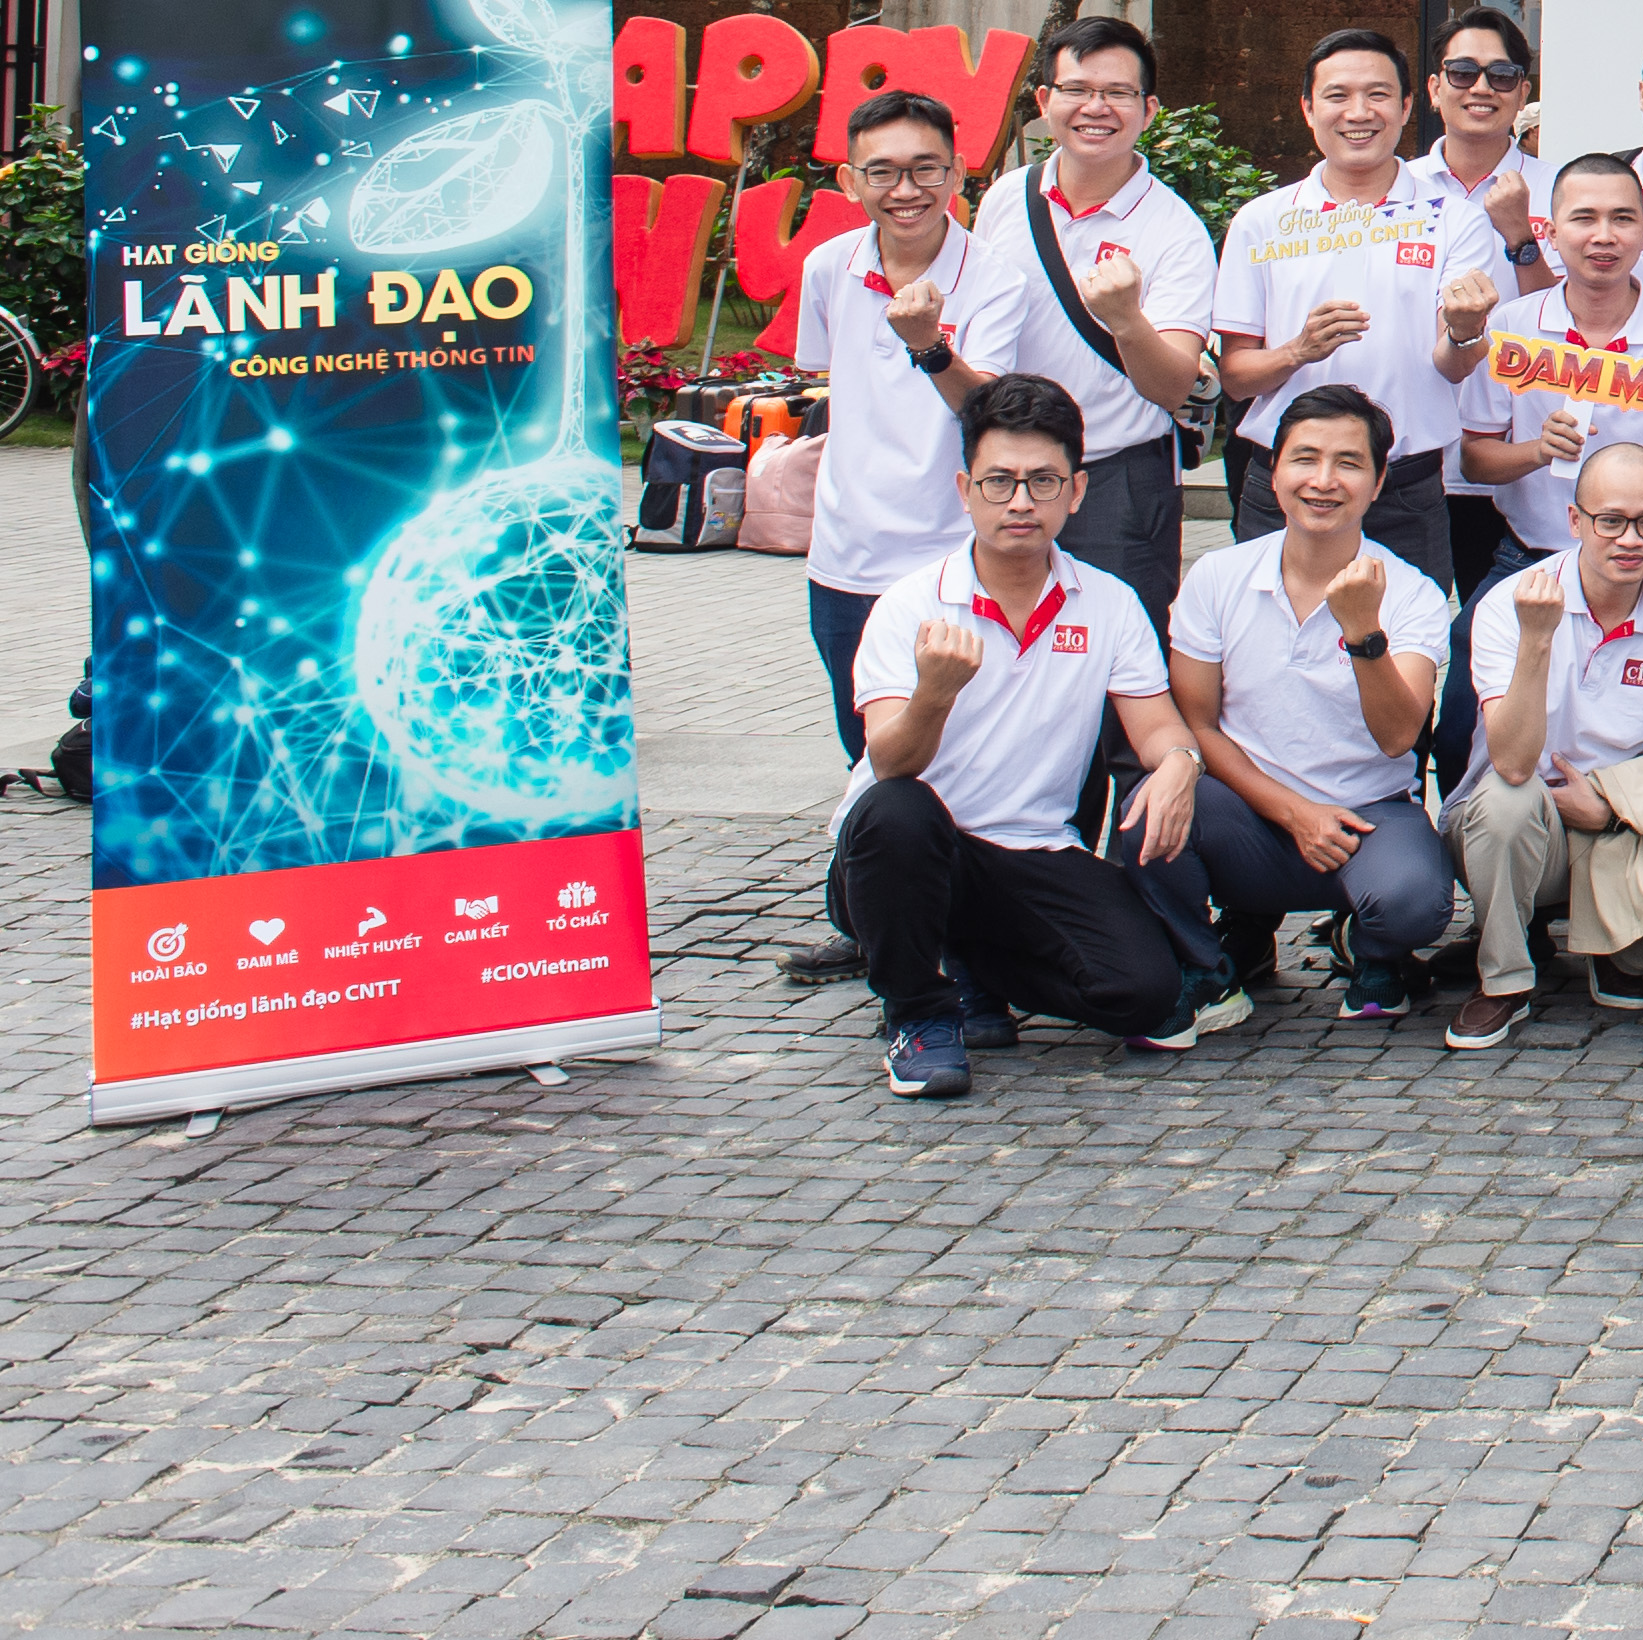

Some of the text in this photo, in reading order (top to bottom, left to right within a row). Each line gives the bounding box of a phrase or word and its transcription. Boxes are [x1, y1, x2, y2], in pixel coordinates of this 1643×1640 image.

[612, 14, 1037, 179] APPY
[1250, 219, 1427, 265] LÃNH ĐẠO CNTT
[124, 265, 535, 344] LÃNH ĐẠO
[229, 344, 537, 378] CÔNG NGHỆ THÔNG TIN
[1496, 339, 1604, 394] ĐAM
[444, 922, 510, 945] CAM KẾT
[545, 910, 610, 933] TỐ CHẤT
[236, 948, 299, 971] ĐAM MÊ
[323, 932, 423, 961] NHIỆT HUYẾT
[130, 960, 208, 984] HOÀI BÃO
[479, 953, 610, 985] #CIOVietnam
[130, 978, 402, 1031] #Hạt giống lãnh đạo CNTT
